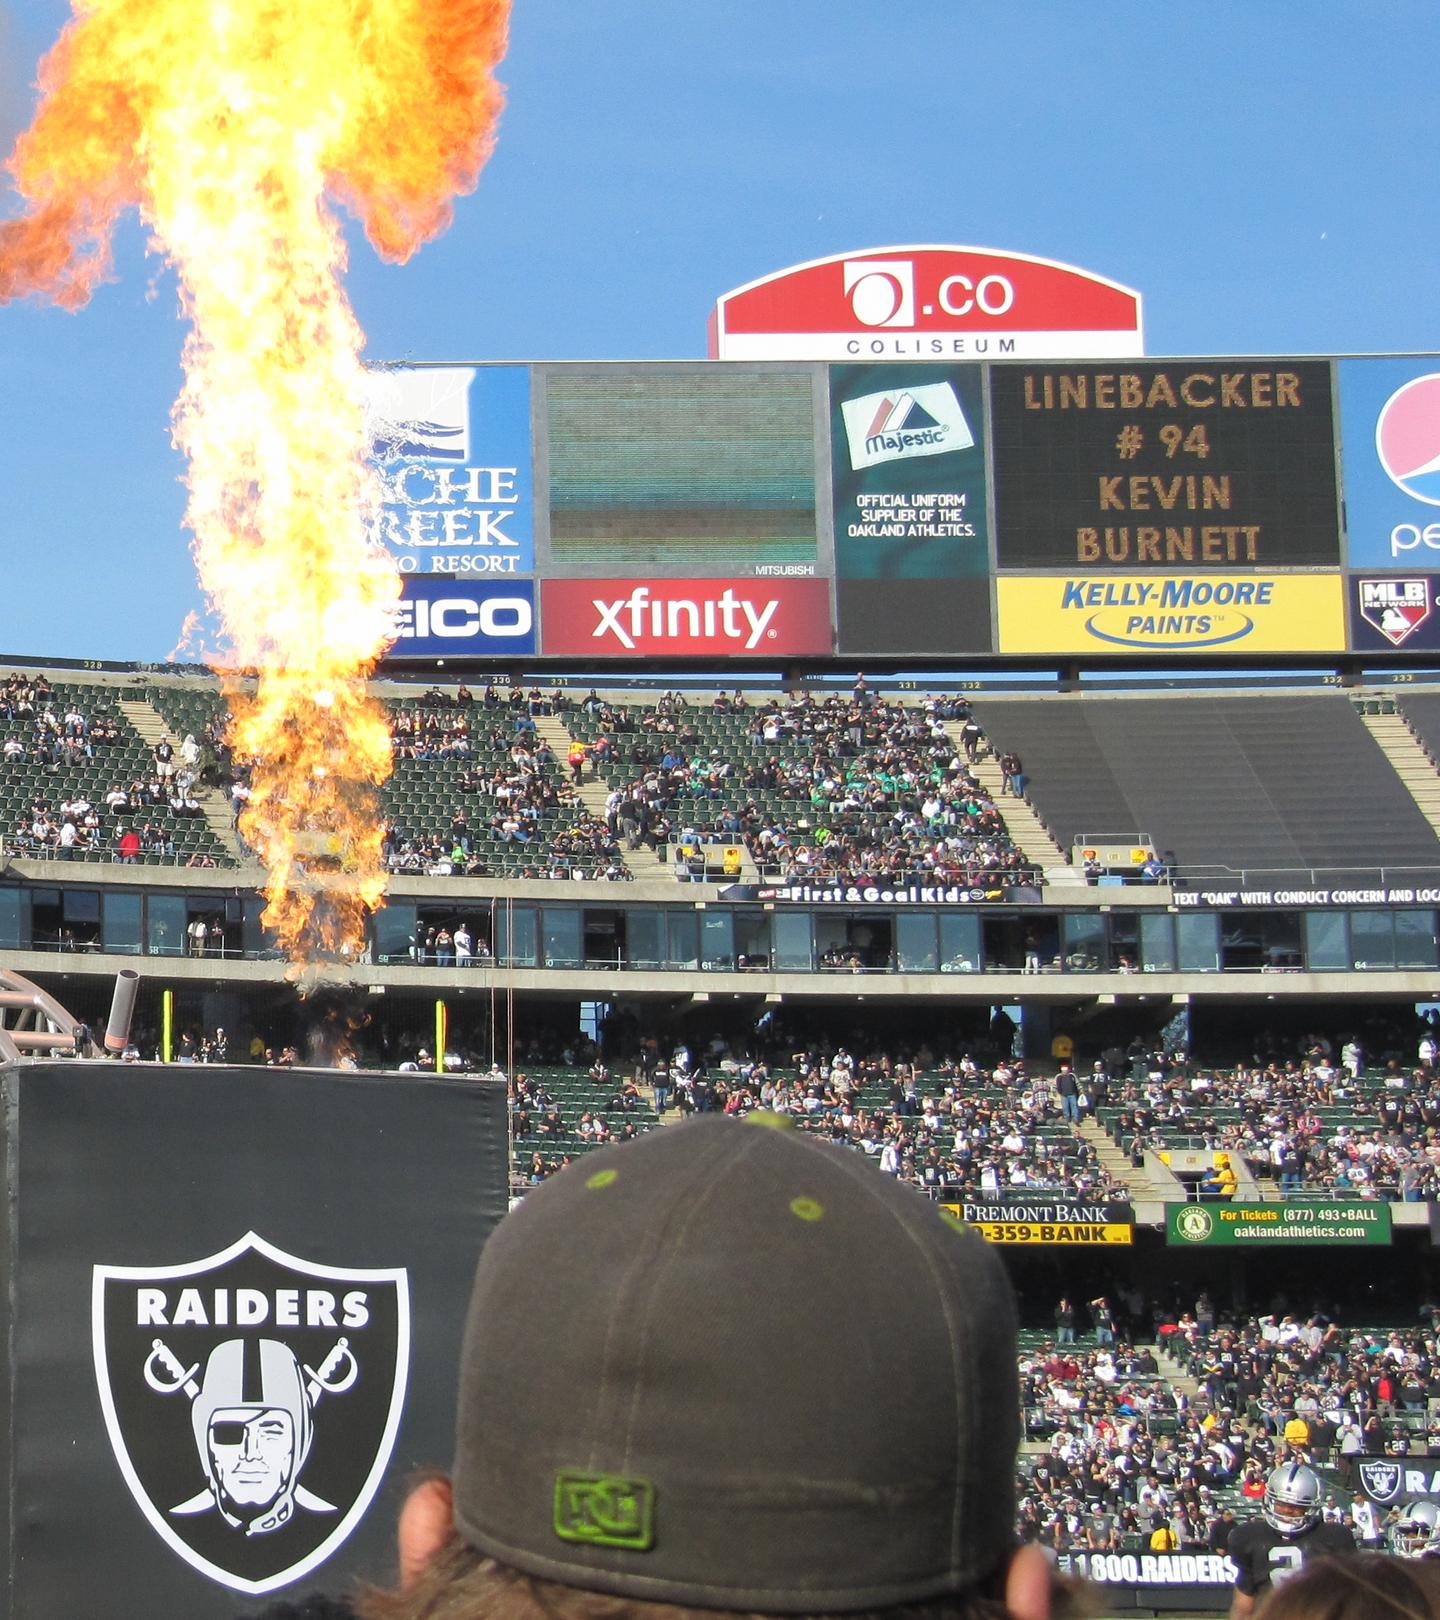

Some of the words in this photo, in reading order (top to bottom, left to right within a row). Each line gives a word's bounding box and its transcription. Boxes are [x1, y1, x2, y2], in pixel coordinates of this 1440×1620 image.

[847, 339, 1016, 354] COLISEUM
[1023, 373, 1302, 409] LINEBACKER
[865, 430, 945, 455] Majestic
[1116, 425, 1143, 459] #
[1159, 424, 1209, 459] 94
[384, 465, 519, 505] CHE
[1099, 475, 1231, 510] KEVIN
[856, 494, 909, 507] OFFICIAL
[912, 494, 965, 507] UNIFORM
[861, 509, 916, 522] SUPPLIER
[919, 509, 933, 522] OF
[938, 509, 962, 522] THE
[372, 508, 519, 547] REEK
[848, 524, 905, 537] OAKLAND
[907, 523, 976, 537] ATHLETICS.
[1076, 526, 1260, 562] BURNETT
[431, 555, 520, 573] RESORT
[755, 565, 815, 576] MITSUBISHI
[1061, 580, 1275, 609] KELLY-MOORE
[1363, 583, 1425, 601] MLB
[393, 597, 532, 638] EICO
[591, 587, 779, 649] xfinity
[1126, 615, 1212, 634] PAINTS
[1322, 676, 1343, 684] 332
[791, 886, 841, 902] First
[863, 886, 916, 902] Goal
[921, 886, 969, 902] Kids
[1173, 892, 1198, 905] TEXT
[1240, 892, 1271, 905] WITH
[1274, 891, 1328, 904] CONDUCT
[1331, 890, 1385, 904] CONCERN
[1388, 890, 1413, 903] AND
[701, 962, 712, 970] 61
[940, 963, 953, 972] 62
[1143, 963, 1156, 972] 63
[963, 1204, 1052, 1222] FREMONT
[1055, 1204, 1108, 1222] BANK
[1220, 1210, 1237, 1221] For
[1240, 1209, 1278, 1221] Tickets
[1283, 1209, 1314, 1222] (877)
[1234, 1225, 1365, 1238] oaklandathletics.com
[137, 1288, 370, 1328] RAIDERS
[1074, 1554, 1240, 1585] 1.800.RAIDERS
